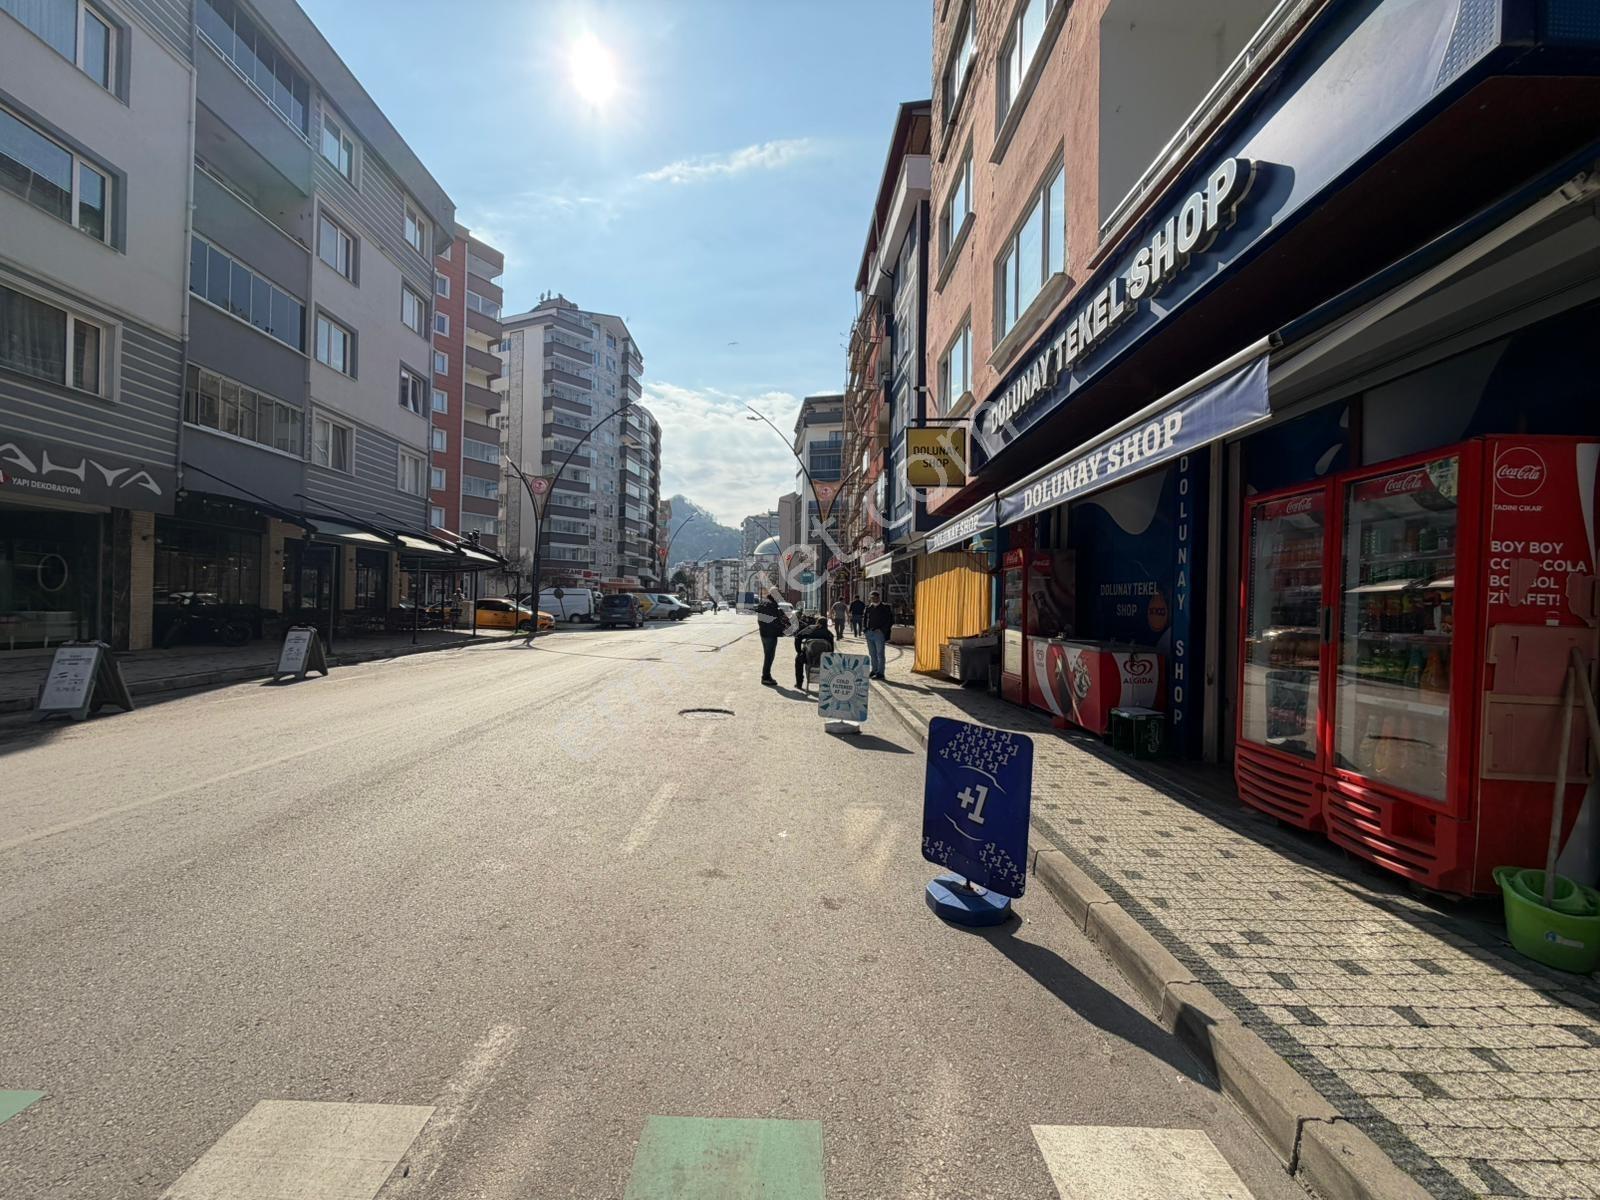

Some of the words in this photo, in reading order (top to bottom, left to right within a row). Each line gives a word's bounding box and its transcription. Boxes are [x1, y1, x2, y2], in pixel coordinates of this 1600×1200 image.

[989, 347, 1054, 433] DOLUNAY
[1053, 276, 1126, 372] TEKEL
[1130, 157, 1240, 300] SHOP
[913, 445, 960, 456] DOLUNAY
[922, 458, 950, 468] SHOP
[1023, 455, 1103, 511] DOLUNAY
[1106, 410, 1184, 474] SHOP
[1496, 463, 1543, 480] Coca-Cola
[12, 477, 30, 488] YAPI
[31, 480, 82, 496] DEKORASYON
[1176, 455, 1188, 610] DOLUNAY
[1491, 540, 1525, 553] BOY
[1529, 542, 1563, 554] BOY
[1490, 557, 1588, 572] CO-COLA
[1100, 583, 1131, 596] DOLUNAY
[1133, 581, 1160, 596] TEKEL
[1490, 589, 1560, 606] ZİFET!
[1116, 604, 1138, 616] SHOP
[1173, 639, 1185, 725] SHOP
[963, 724, 971, 734] +1
[974, 728, 983, 738] +1
[986, 730, 996, 741] +1
[1000, 733, 1012, 744] +1
[948, 740, 957, 750] +1
[960, 744, 969, 754] +1
[972, 747, 980, 757] +1
[983, 751, 993, 761] +1
[998, 754, 1009, 765] +1
[956, 732, 965, 742] +1
[967, 735, 976, 746] +1
[979, 739, 988, 749] +1
[991, 742, 1002, 753] +1
[1006, 744, 1019, 756] +1
[939, 748, 949, 759] +1
[953, 751, 961, 762] +1
[964, 755, 973, 765] +1
[975, 759, 984, 769] +1
[987, 762, 998, 773] +1
[956, 784, 989, 825] +1
